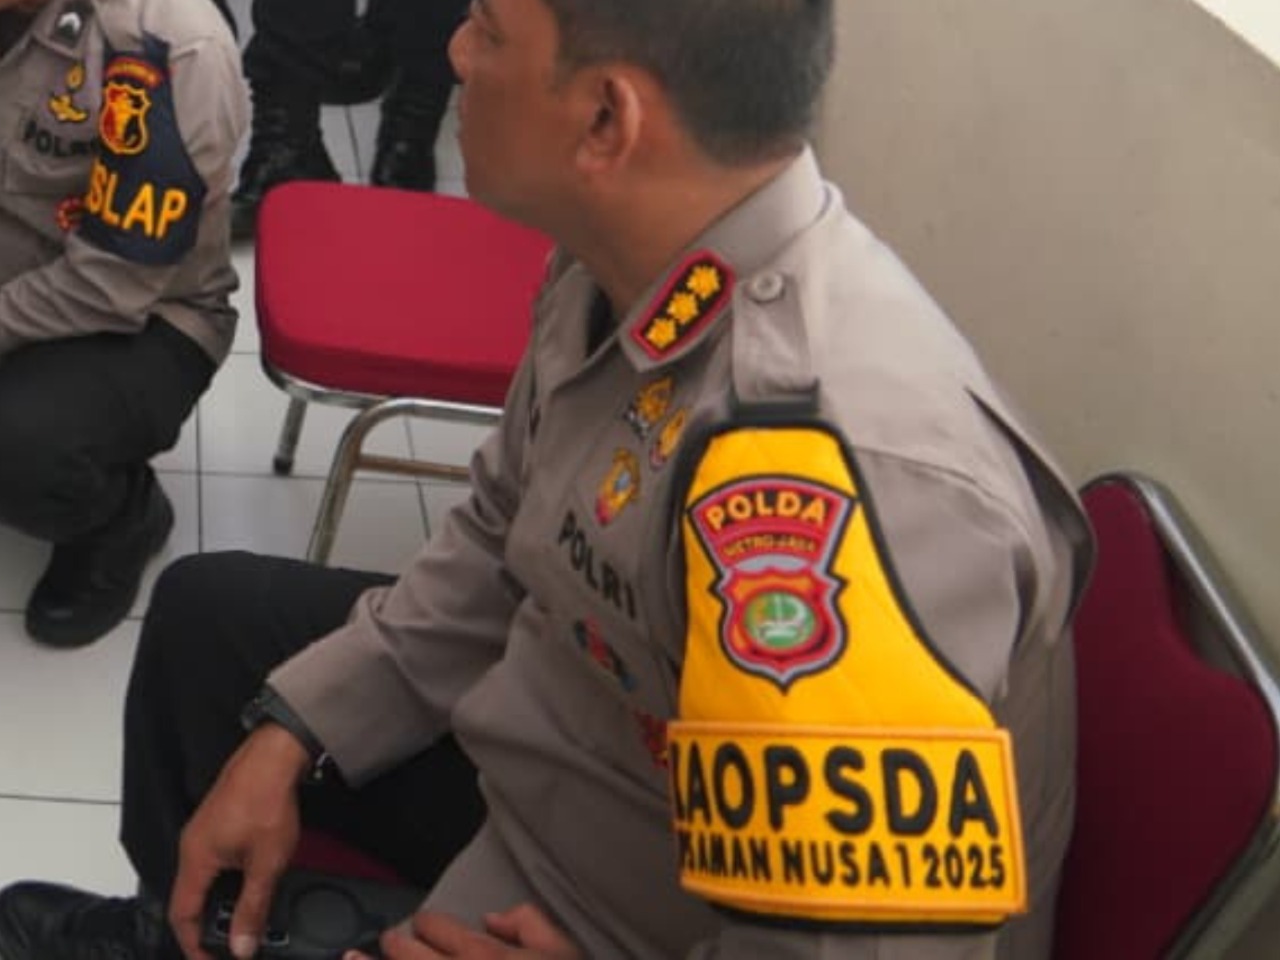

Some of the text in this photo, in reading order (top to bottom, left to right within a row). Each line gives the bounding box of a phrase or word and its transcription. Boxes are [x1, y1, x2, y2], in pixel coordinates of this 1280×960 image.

[706, 489, 827, 531] POLDA
[559, 508, 636, 620] POLRI
[922, 843, 1006, 888] 2025
